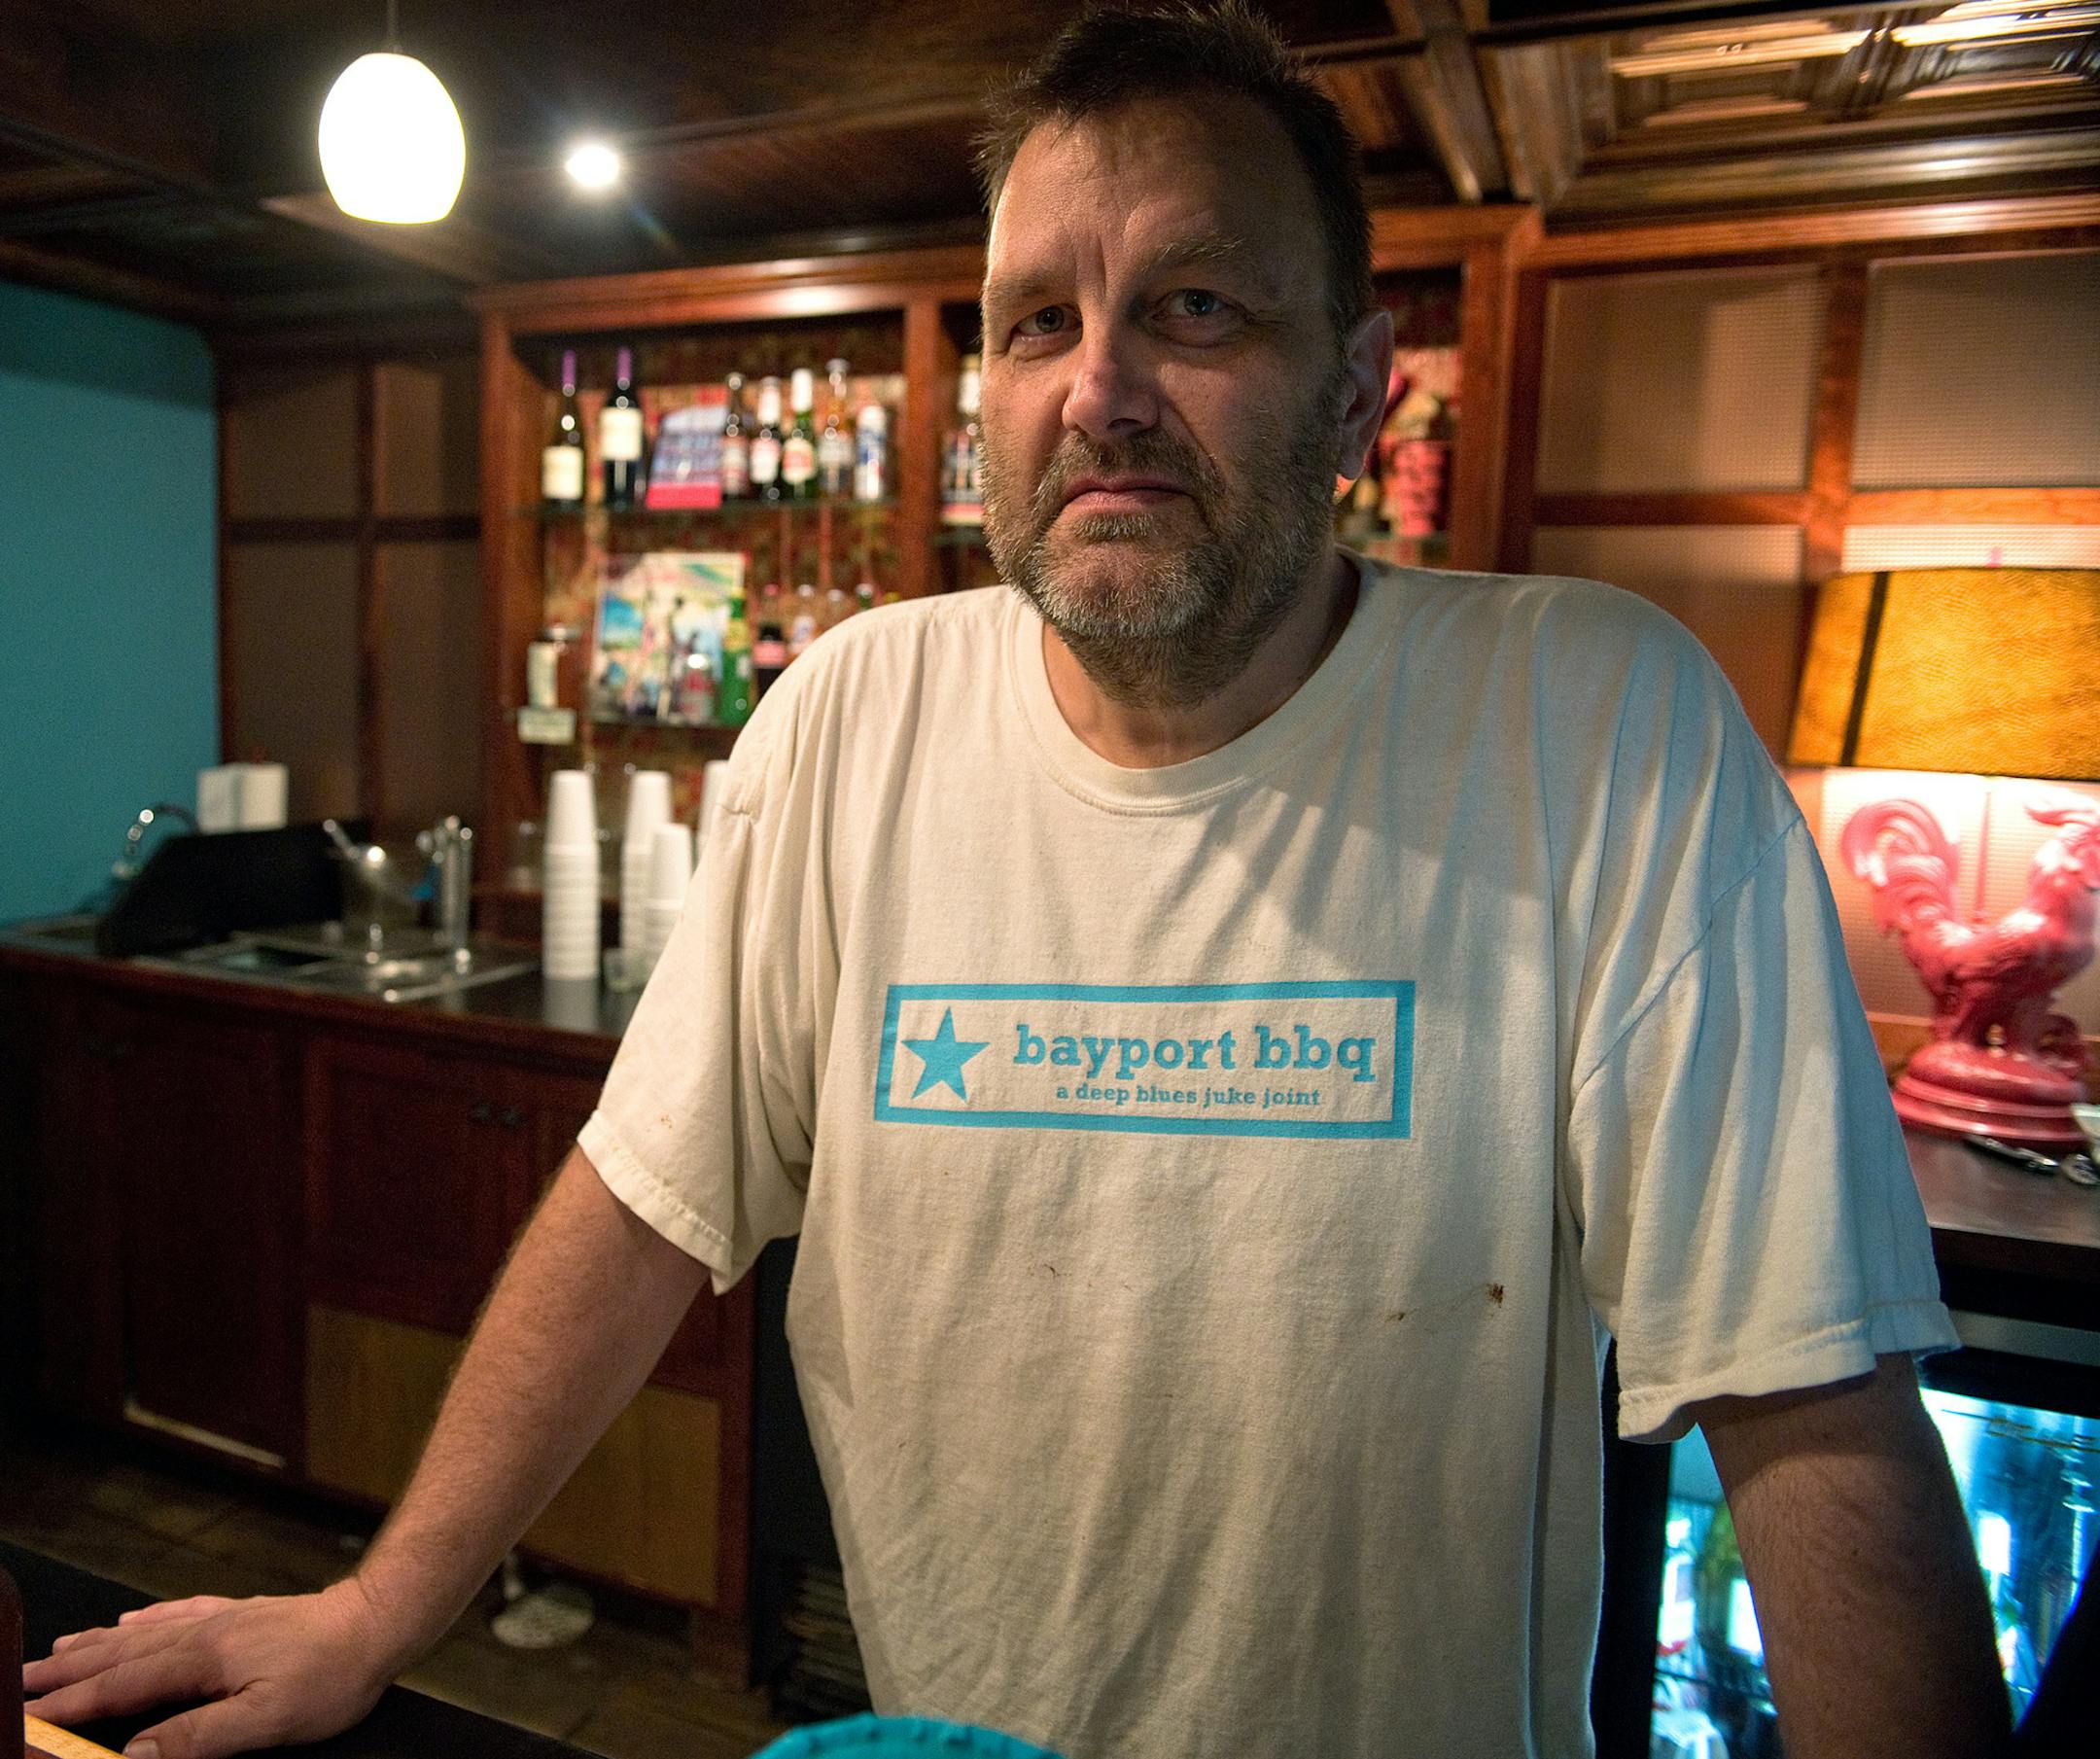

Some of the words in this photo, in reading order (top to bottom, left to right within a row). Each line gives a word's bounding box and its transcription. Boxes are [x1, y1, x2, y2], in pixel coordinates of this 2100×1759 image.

[1013, 1023, 1238, 1080] bayport
[1253, 1024, 1378, 1083] bbq
[1057, 1087, 1069, 1100] a
[1075, 1083, 1131, 1106] deep
[1136, 1086, 1198, 1105] blues
[1204, 1088, 1256, 1108] juke
[1263, 1089, 1320, 1108] joint
